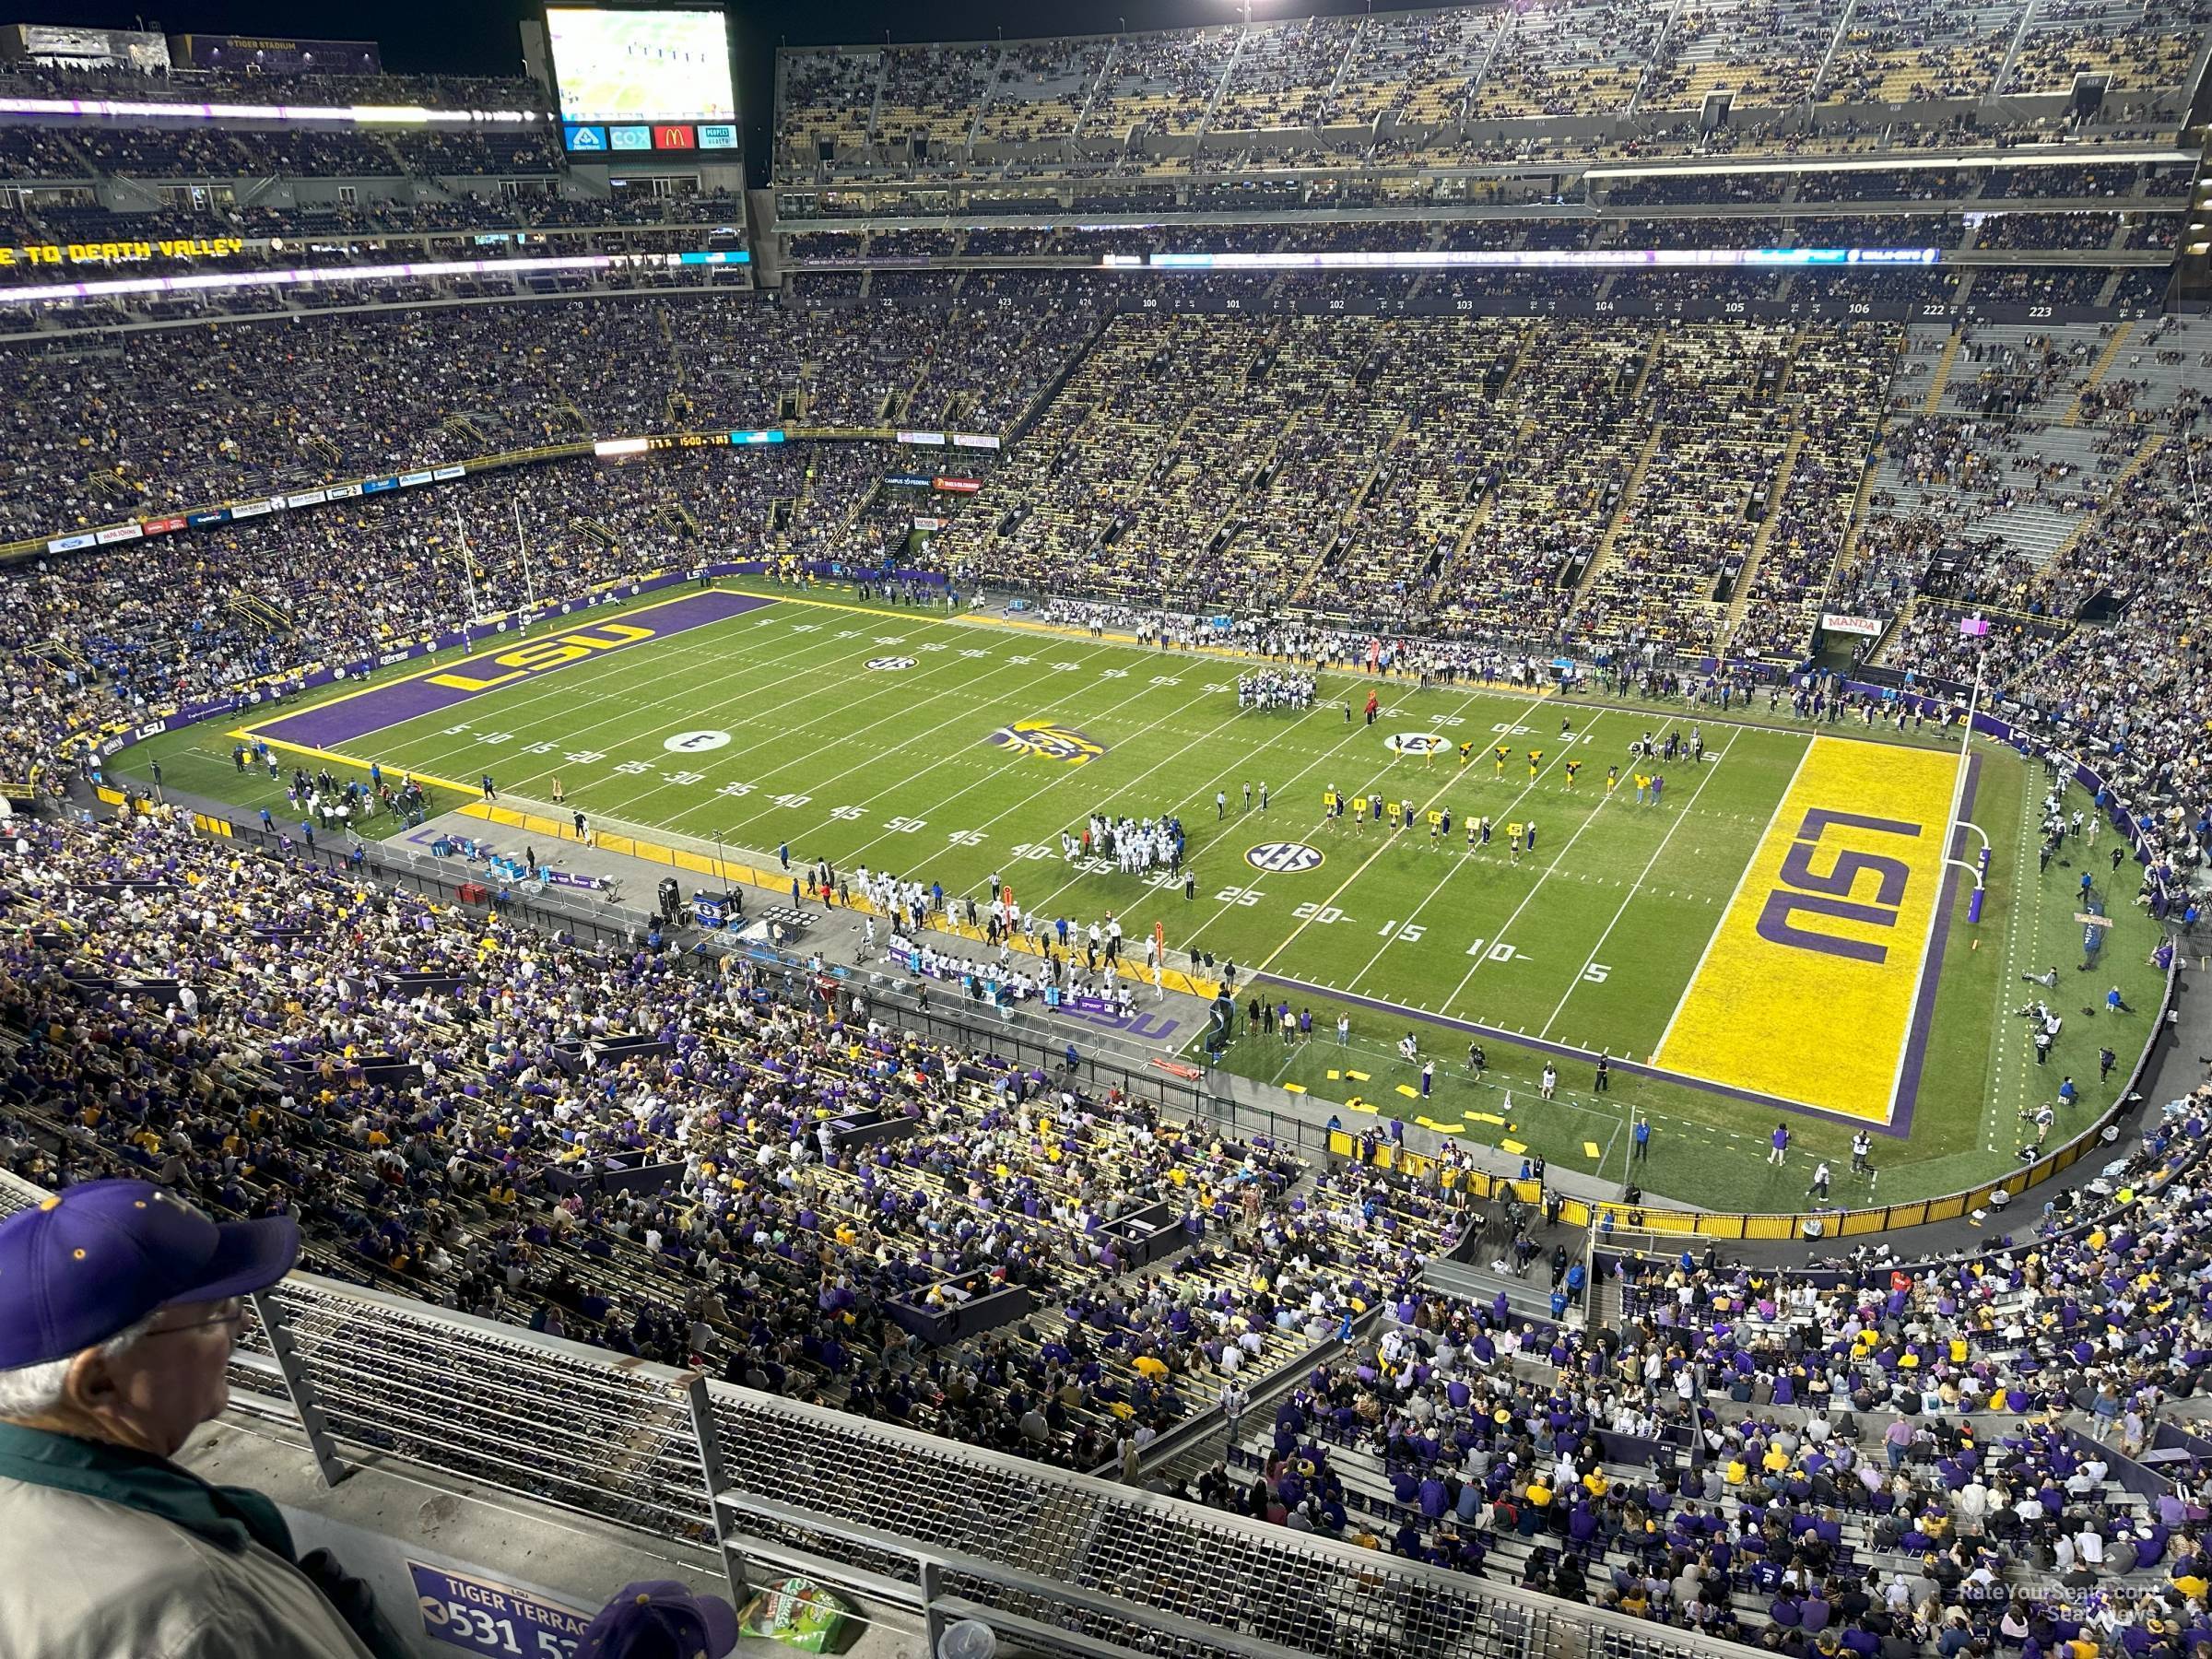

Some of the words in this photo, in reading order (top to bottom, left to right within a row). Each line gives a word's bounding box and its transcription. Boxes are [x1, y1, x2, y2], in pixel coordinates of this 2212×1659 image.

[234, 41, 257, 49] TIGER
[259, 41, 296, 51] STADIUM
[611, 131, 648, 146] COX
[24, 245, 63, 264] TO
[67, 241, 152, 261] DEATH
[158, 238, 243, 256] VALLEY
[880, 298, 892, 306] 22
[1330, 300, 1344, 309] 102
[1456, 300, 1473, 310] 103
[1595, 301, 1614, 311] 104
[1725, 302, 1745, 312] 105
[1849, 304, 1870, 313] 106
[1923, 305, 1945, 315] 222
[2029, 307, 2052, 317] 223
[1828, 618, 1876, 631] MANDA
[424, 623, 656, 692] LSU
[1427, 714, 1466, 726] 25
[135, 720, 166, 740] LSU
[443, 724, 471, 735] 5
[1490, 723, 1532, 735] 20
[476, 732, 514, 744] 10
[1557, 732, 1594, 745] 15
[520, 741, 560, 754] 15
[564, 750, 607, 764] 20
[613, 760, 656, 774] 25
[663, 771, 707, 785] 30
[715, 782, 759, 796] 35
[773, 794, 813, 808] 40
[830, 806, 870, 820] 45
[882, 816, 928, 833] 50
[948, 830, 989, 847] 45
[1010, 842, 1053, 860] 40
[1248, 841, 1324, 872] SEC
[1072, 855, 1120, 875] 35
[1142, 870, 1186, 890] 30
[1755, 807, 1923, 965] LSU
[1214, 886, 1265, 907] 25
[1291, 901, 1344, 924] 20
[1377, 920, 1428, 942] 15
[1465, 938, 1517, 962] 10
[1583, 963, 1612, 983] 5
[1386, 1303, 1394, 1312] 27
[1386, 1338, 1393, 1352] 1
[1230, 1395, 1234, 1407] 1
[1762, 1572, 1773, 1584] 2
[446, 1578, 507, 1612] TIGER
[510, 1599, 590, 1636] TERRAC
[448, 1601, 523, 1655] 531
